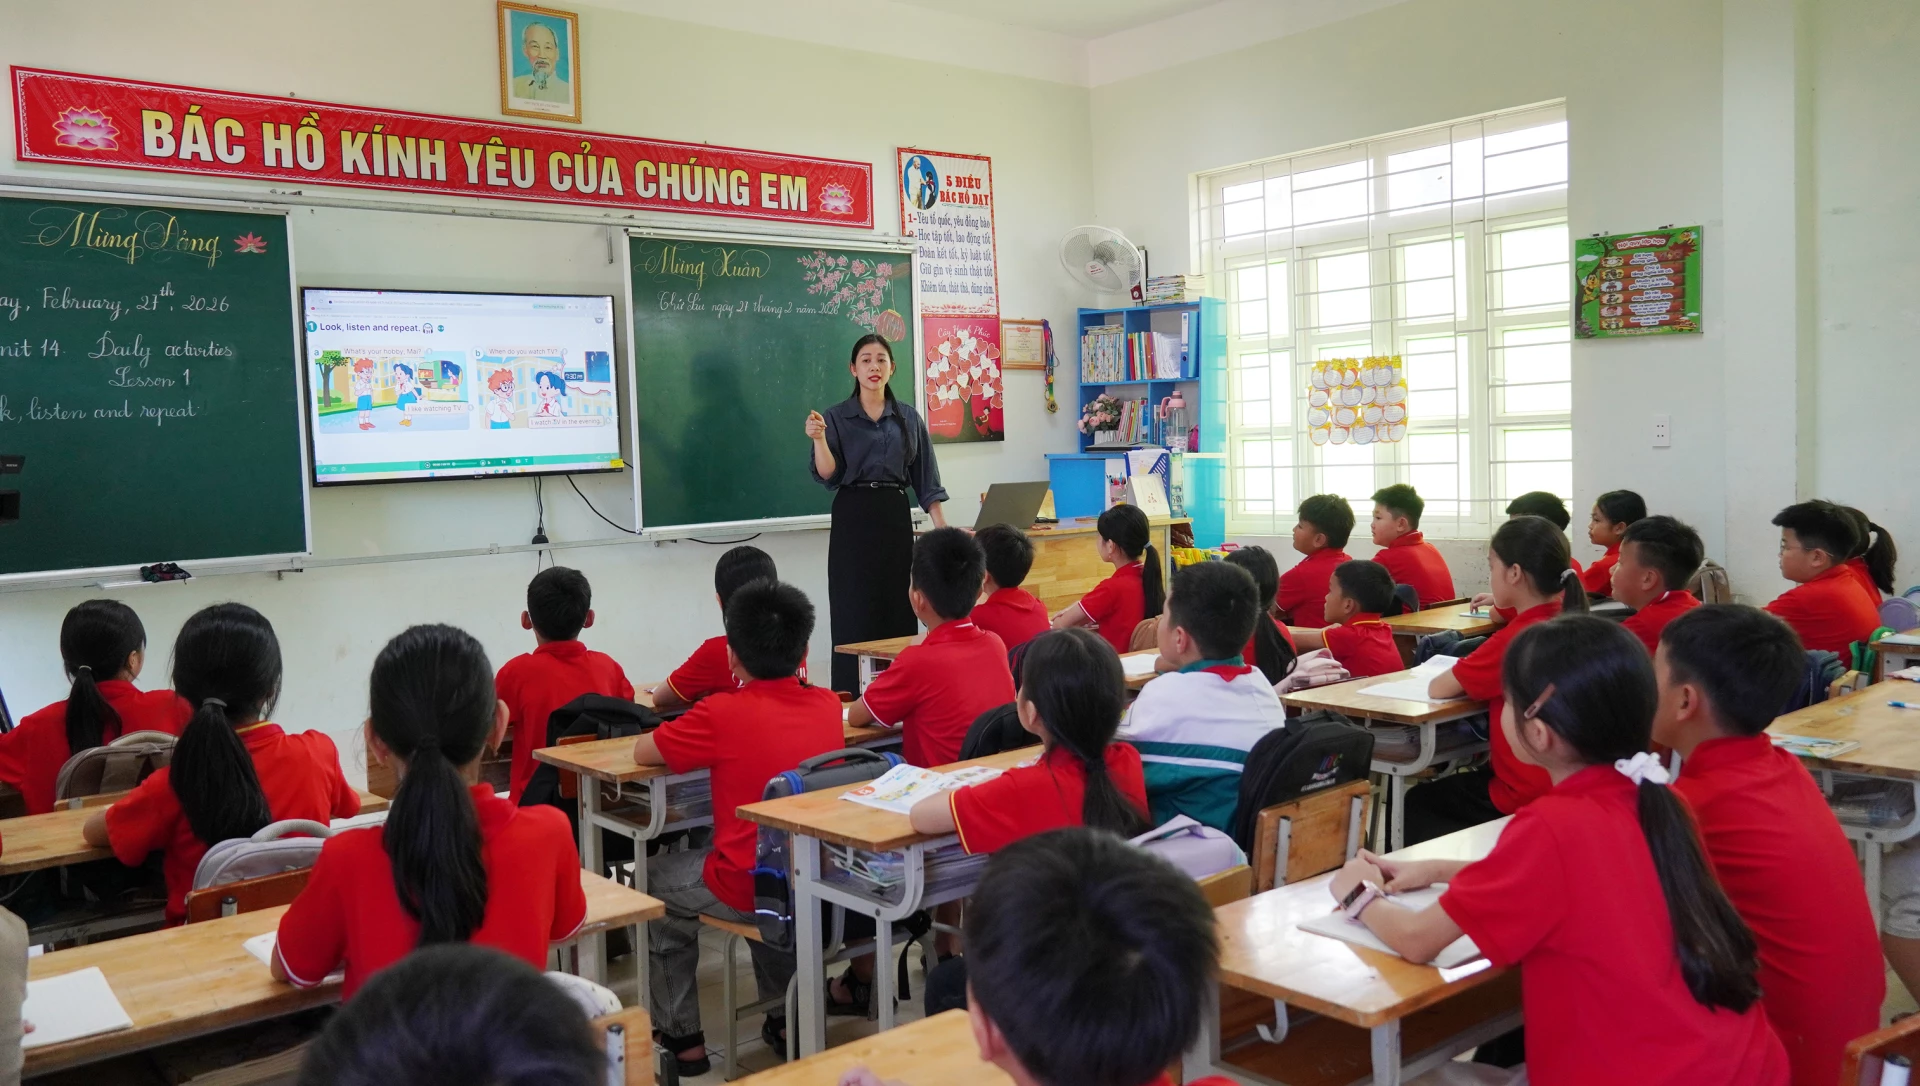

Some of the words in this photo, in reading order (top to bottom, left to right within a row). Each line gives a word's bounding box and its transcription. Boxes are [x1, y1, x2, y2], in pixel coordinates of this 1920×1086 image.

[141, 105, 246, 164] BÁC
[261, 112, 326, 171] HỒ
[340, 124, 447, 182] KÍNH
[458, 136, 536, 189] YÊU
[548, 141, 624, 196] CỦA
[634, 158, 750, 206] CHÚNG
[760, 172, 808, 212] EM
[946, 175, 952, 187] 5
[955, 174, 981, 189] ĐIỀU
[940, 189, 956, 203] BÁC
[958, 189, 970, 204] HỒ
[938, 213, 952, 228] quốc,
[954, 215, 964, 228] yêu
[965, 214, 979, 230] đồng
[980, 216, 990, 228] bào
[26, 207, 144, 264] Mừng
[135, 210, 222, 269] Đảng
[918, 229, 930, 243] Học
[932, 230, 942, 244] tập
[944, 229, 954, 244] tốt,
[956, 231, 965, 242] lao
[966, 232, 981, 246] động
[982, 232, 991, 244] tốt
[919, 246, 935, 258] Đoàn
[937, 246, 947, 259] kết
[948, 247, 959, 261] tốt,
[634, 240, 707, 290] Mừng
[920, 262, 931, 275] Giữ
[934, 264, 943, 277] gìn
[945, 264, 952, 277] vệ
[954, 264, 968, 276] sinh
[970, 264, 982, 278] thật
[43, 286, 130, 321] February,
[182, 295, 230, 312] 2026
[658, 291, 684, 311] Thứ
[711, 300, 734, 318] ngày
[736, 301, 748, 313] 27
[753, 294, 783, 319] tháng
[784, 302, 793, 314] 2
[796, 304, 816, 314] năm
[320, 323, 344, 332] Look,
[346, 323, 371, 332] listen
[373, 324, 389, 332] and
[390, 325, 421, 335] repeat.
[938, 328, 951, 338] Cây
[974, 326, 991, 338] Phúc
[88, 330, 152, 368] Daily
[164, 340, 233, 358] activities
[383, 348, 406, 357] hobby,
[108, 366, 175, 388] Lesson
[183, 368, 191, 386] 1
[26, 397, 86, 420] listen
[94, 400, 132, 418] and
[139, 404, 198, 426] repeat
[423, 404, 451, 413] watching
